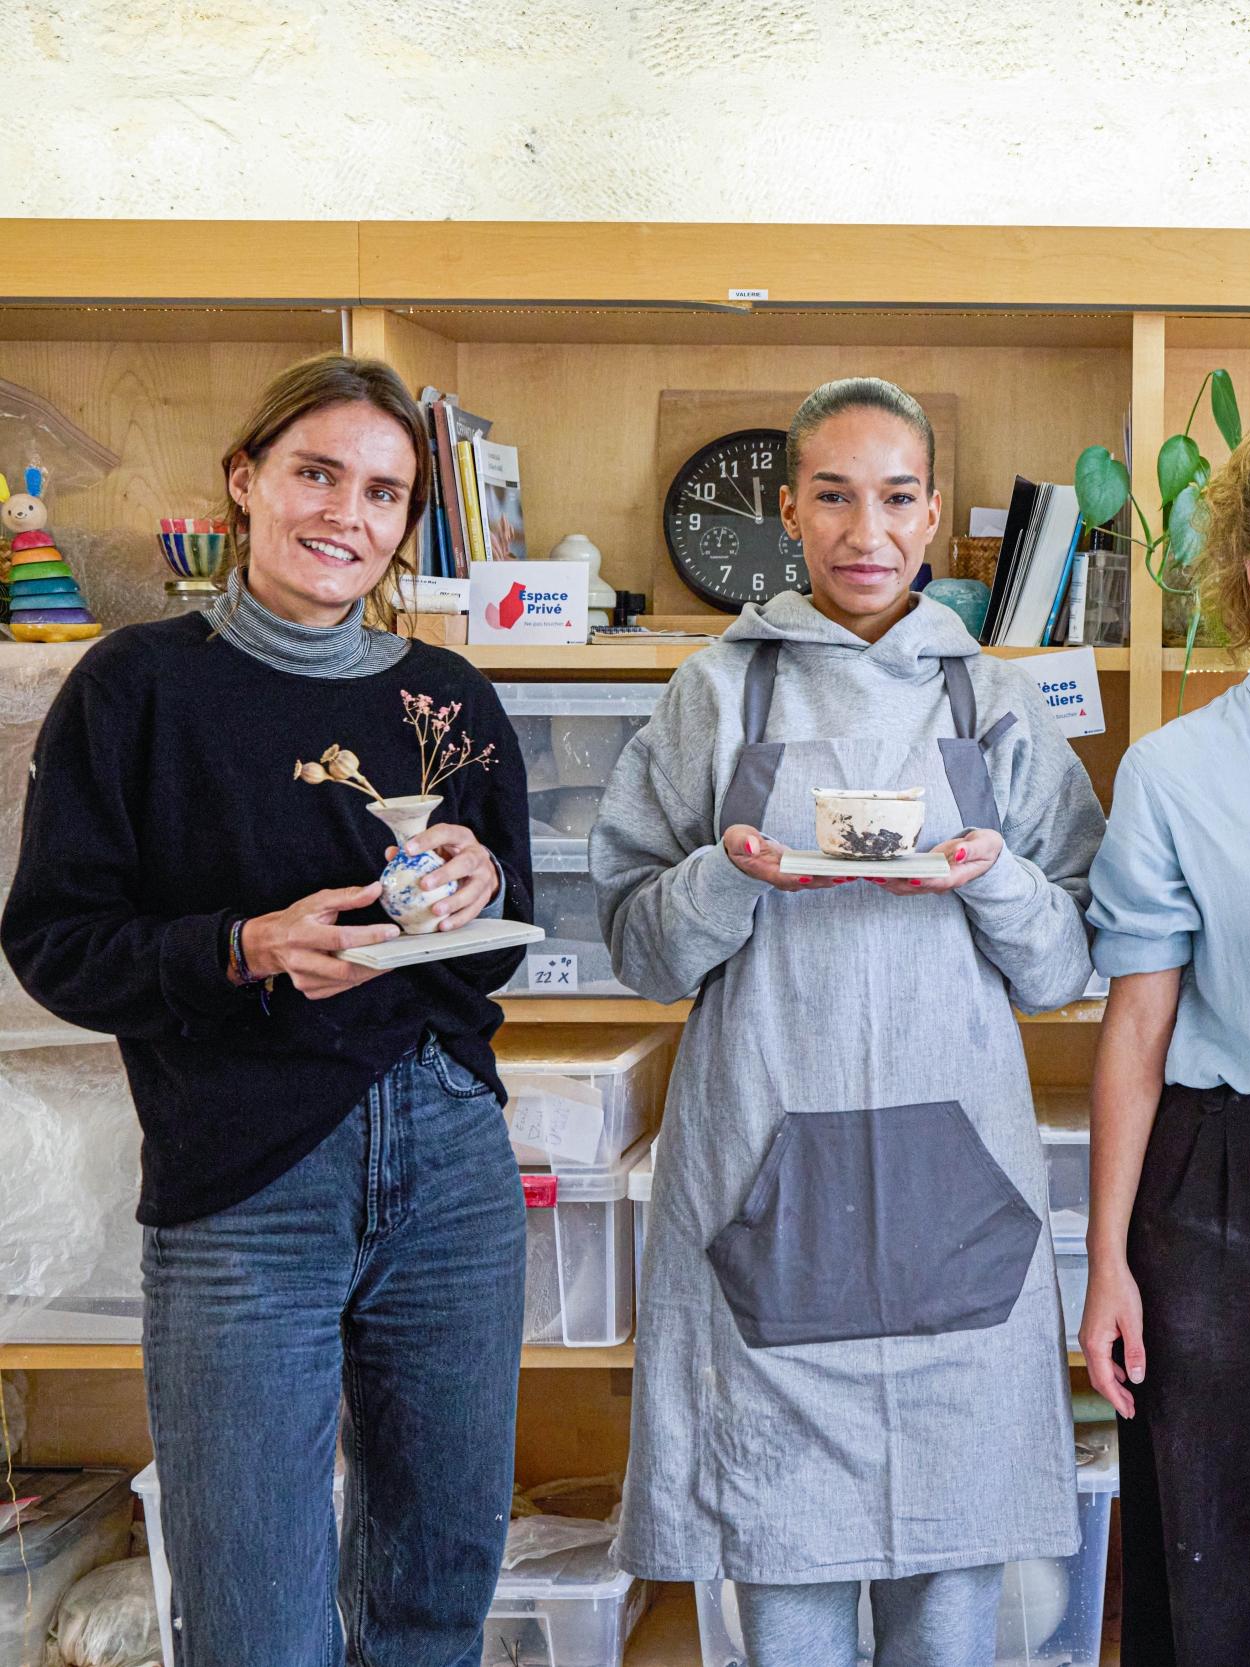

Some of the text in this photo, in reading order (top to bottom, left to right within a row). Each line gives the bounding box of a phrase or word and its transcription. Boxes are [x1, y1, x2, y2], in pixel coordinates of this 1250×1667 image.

[720, 460, 739, 478] 11
[751, 452, 772, 469] 12
[694, 483, 716, 500] 10
[689, 513, 701, 531] 9
[720, 565, 732, 583] 7
[785, 564, 797, 582] 5
[753, 573, 764, 591] 6
[519, 590, 568, 603] Espace
[527, 603, 562, 615] Privé
[1038, 680, 1077, 693] èces
[535, 971, 551, 983] 22
